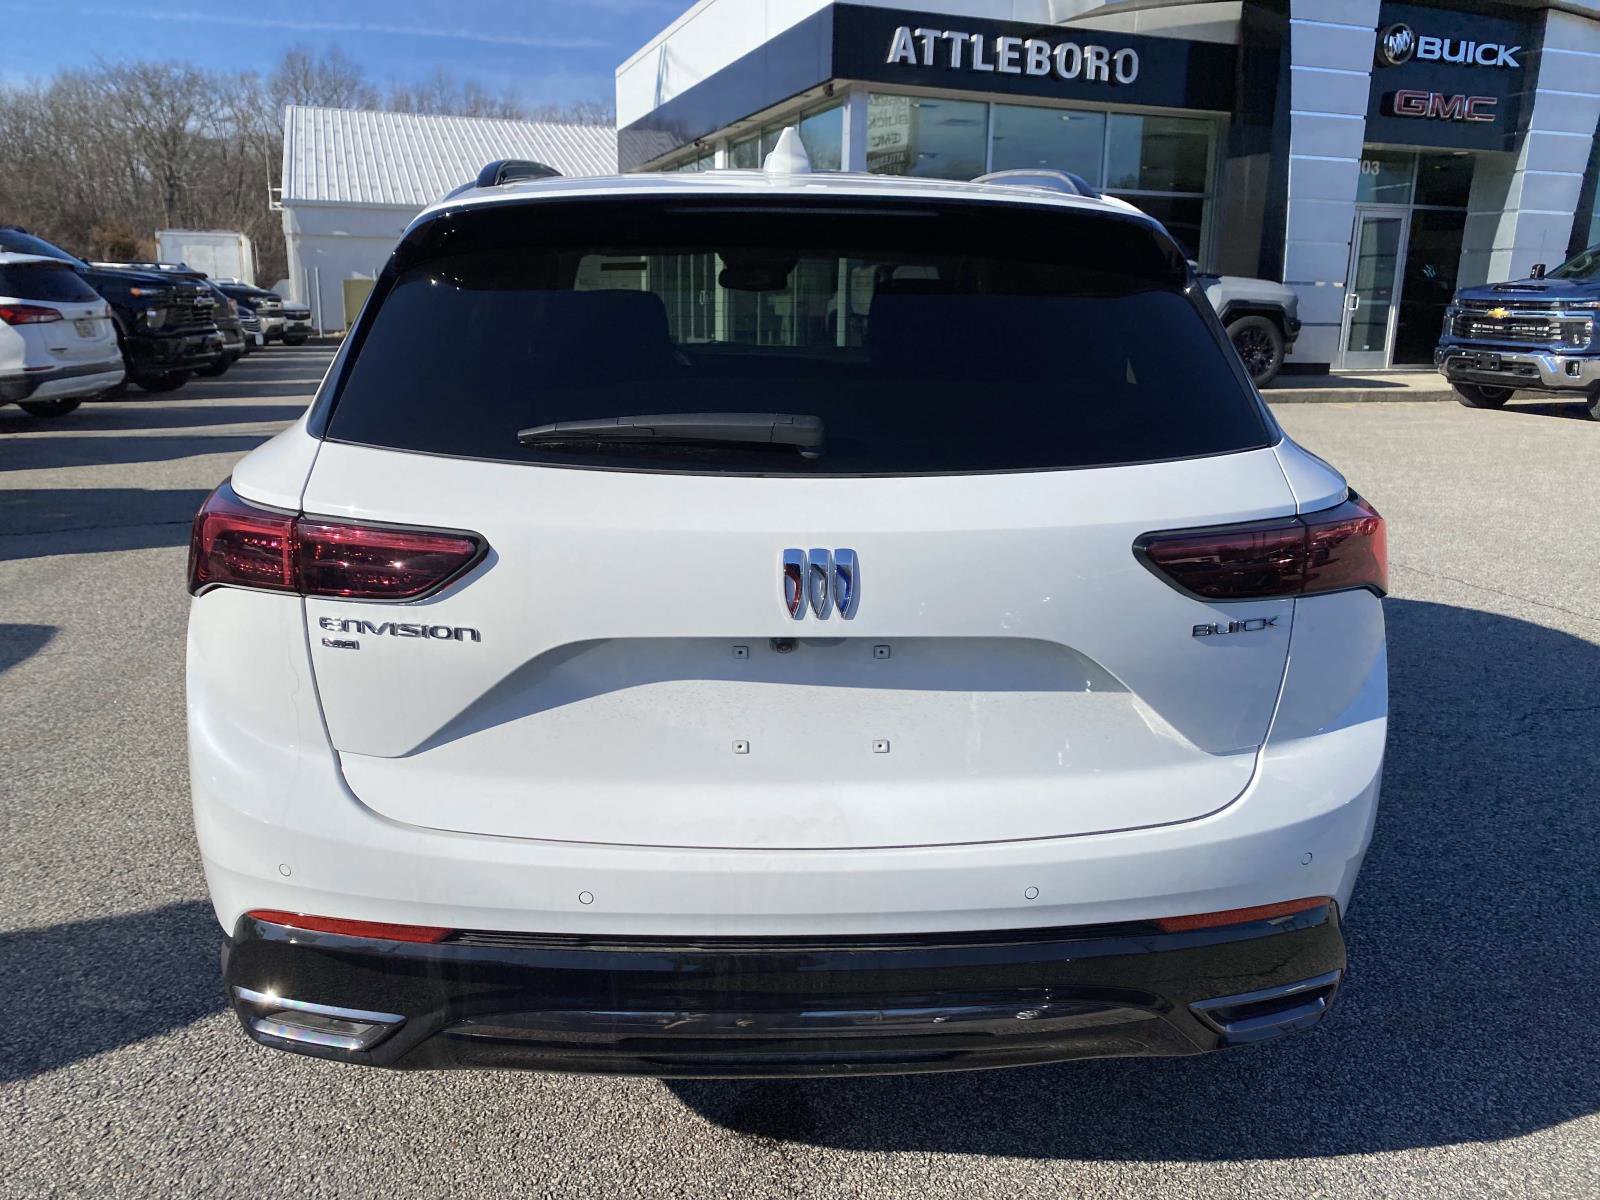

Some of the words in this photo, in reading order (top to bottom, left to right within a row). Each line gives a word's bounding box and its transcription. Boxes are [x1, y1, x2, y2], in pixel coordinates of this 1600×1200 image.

[886, 26, 1139, 84] ATTLEBORO
[1416, 36, 1521, 68] BUICK
[1393, 89, 1498, 122] GMC
[1360, 160, 1380, 176] 03
[318, 616, 481, 642] ENVISION
[1192, 616, 1280, 637] BUICK
